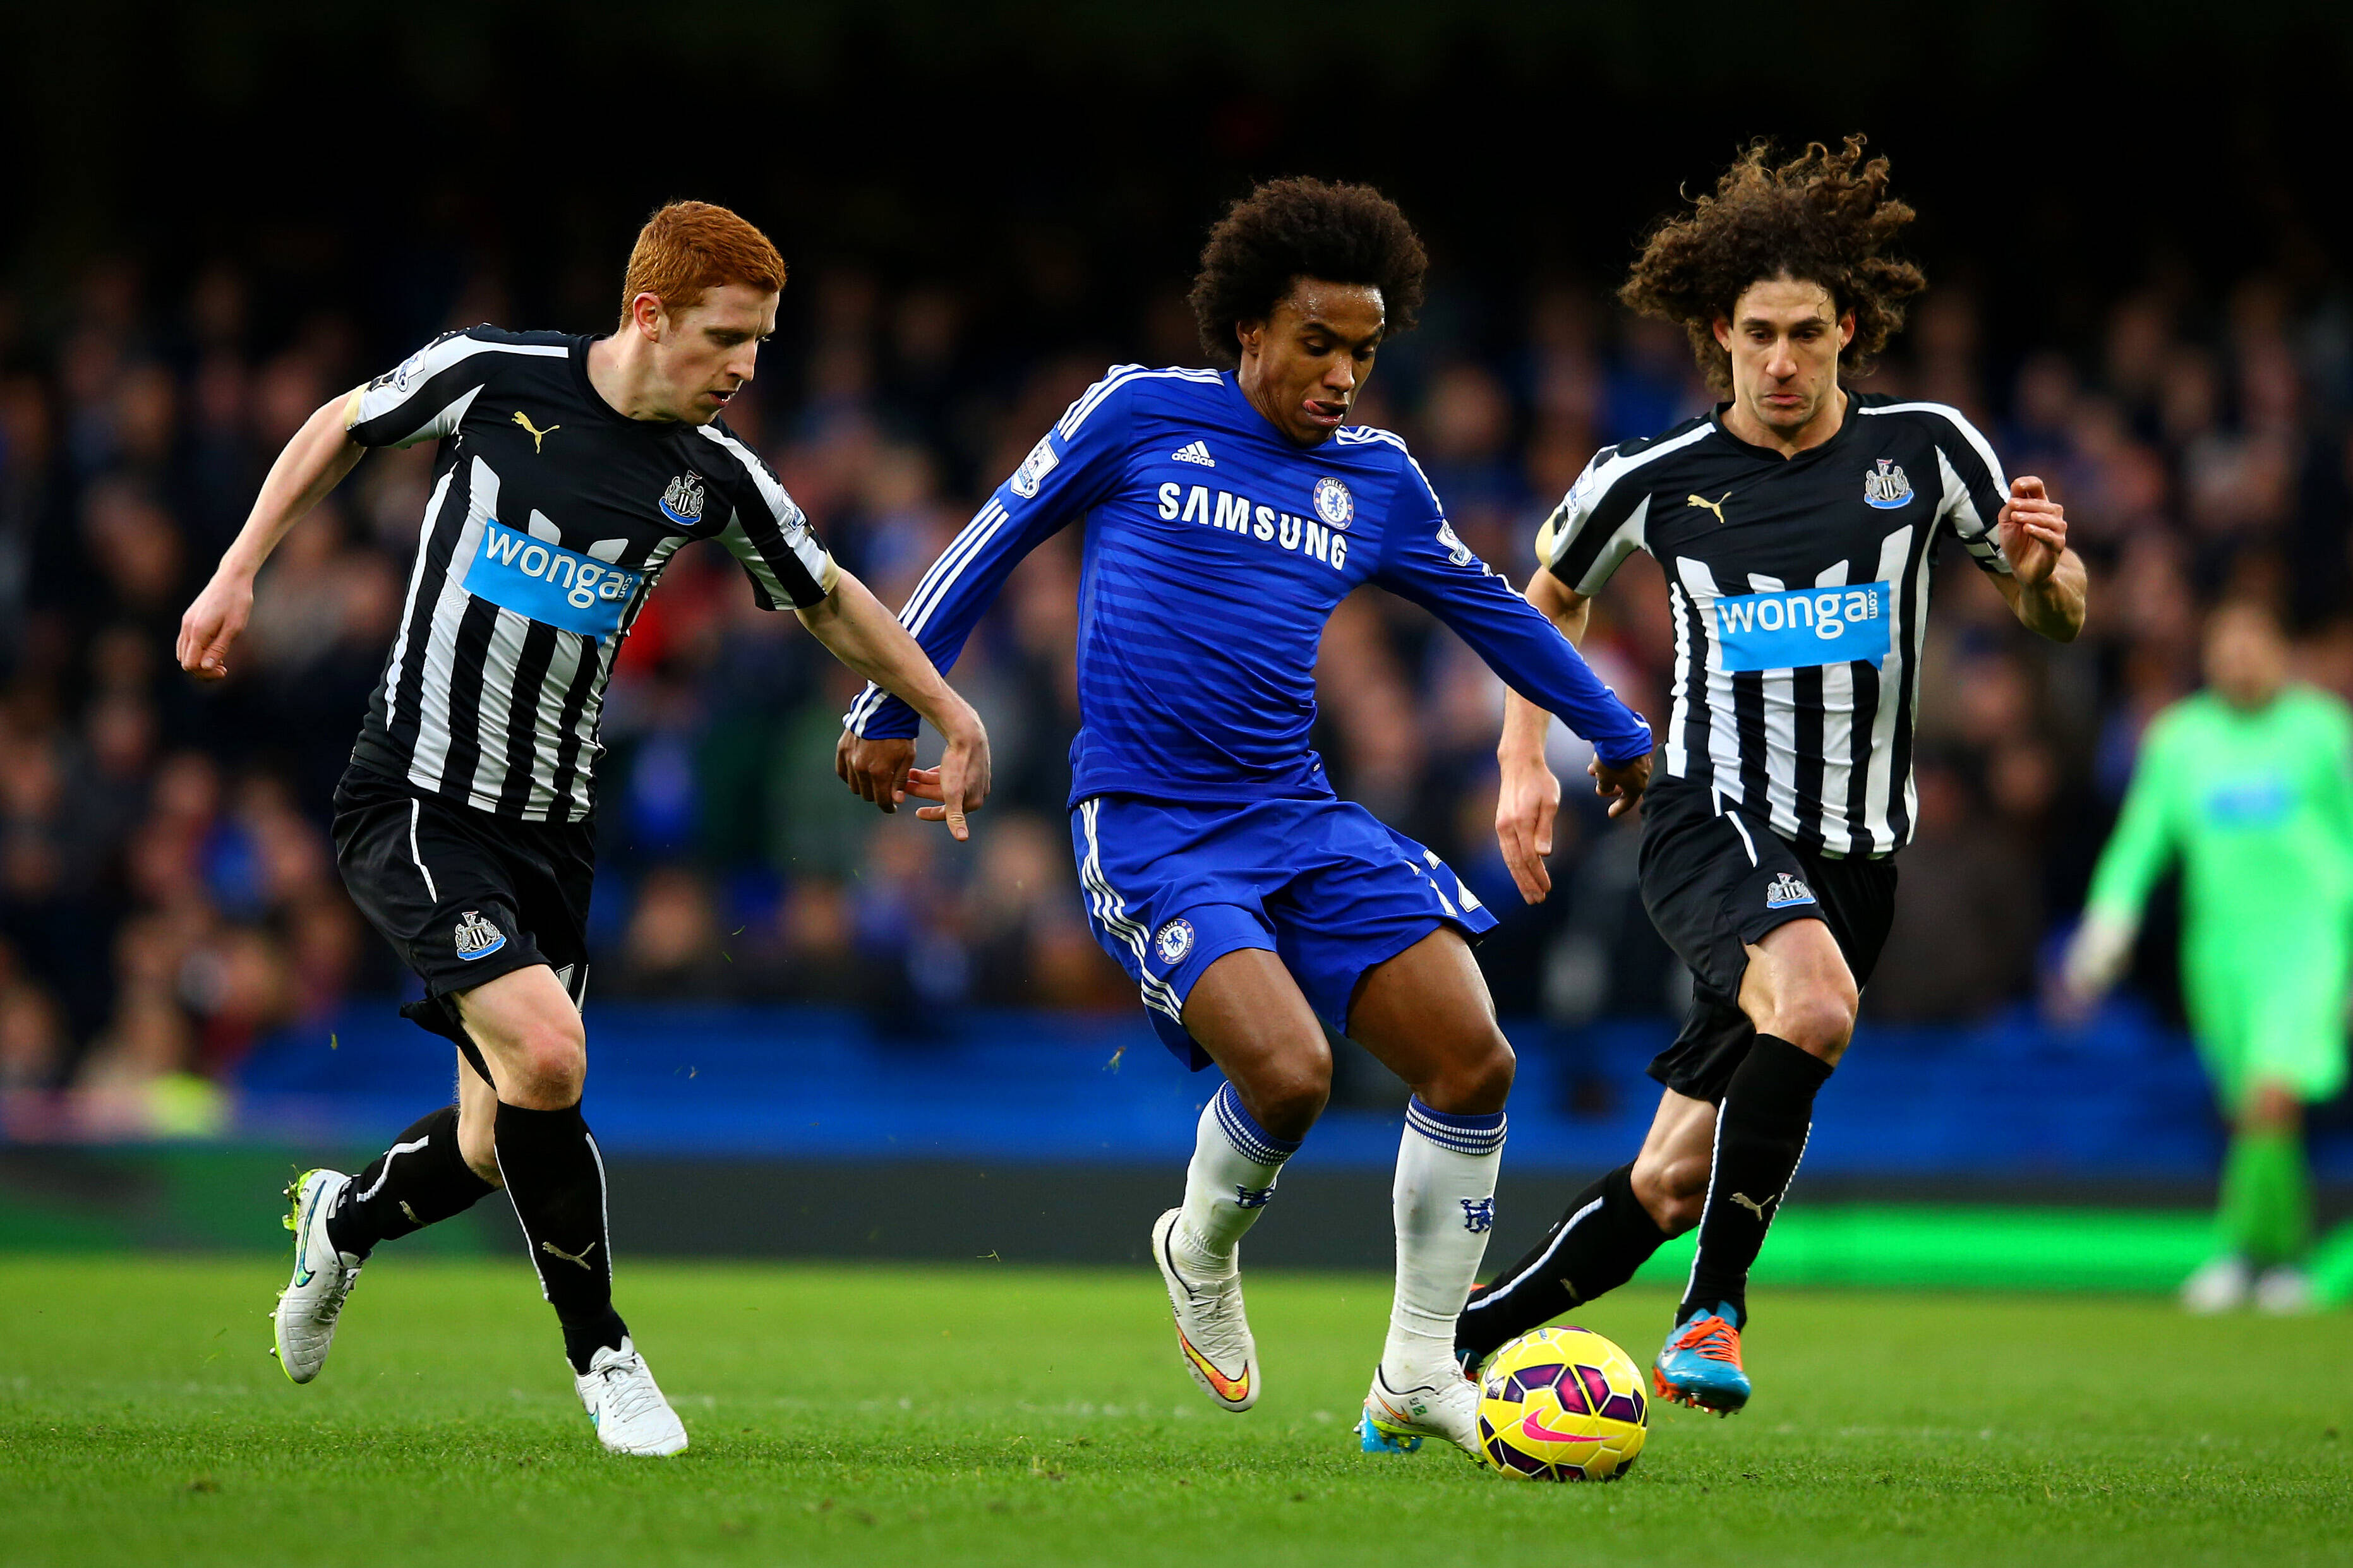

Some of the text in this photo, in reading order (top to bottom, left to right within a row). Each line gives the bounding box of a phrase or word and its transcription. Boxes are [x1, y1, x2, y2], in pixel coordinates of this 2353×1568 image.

[1171, 452, 1215, 467] adidas
[1322, 479, 1349, 498] CHELSEA
[1157, 482, 1348, 571] SAMSUNG
[485, 525, 625, 609] wonga
[1717, 590, 1869, 640] wonga
[1157, 921, 1178, 945] CHELSEA
